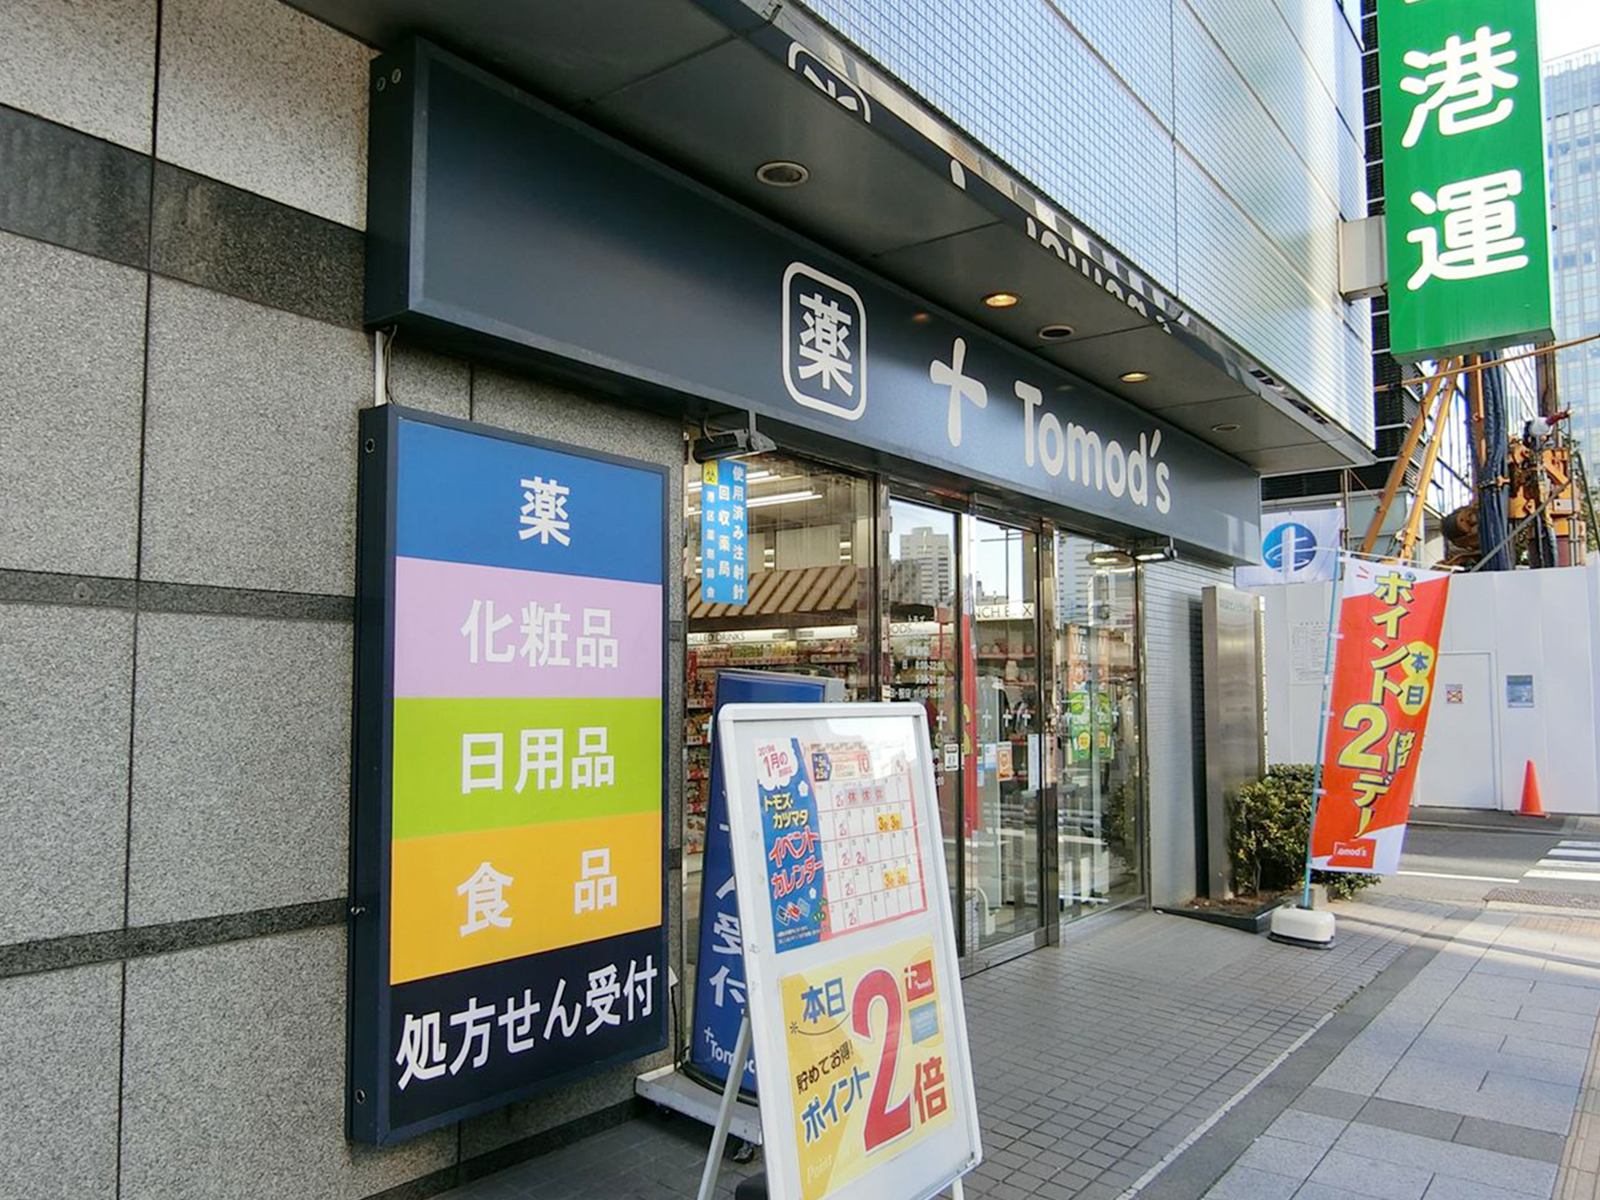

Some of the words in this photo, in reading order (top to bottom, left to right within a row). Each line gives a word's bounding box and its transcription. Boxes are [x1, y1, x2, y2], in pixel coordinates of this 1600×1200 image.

[1400, 26, 1529, 291] 港運
[798, 292, 854, 397] 薬
[1014, 380, 1171, 515] Tomod's
[518, 475, 572, 547] 薬
[460, 598, 619, 669] 化粧品
[687, 634, 714, 643] HILLED
[1401, 650, 1430, 707] 本日
[461, 726, 615, 795] 日用品
[768, 825, 819, 868] イベント
[771, 854, 824, 900] カレンダー
[456, 847, 618, 938] 食品
[396, 953, 658, 1091] 処方せん受付
[801, 977, 846, 1025] 本日
[802, 1065, 871, 1144] ポイント
